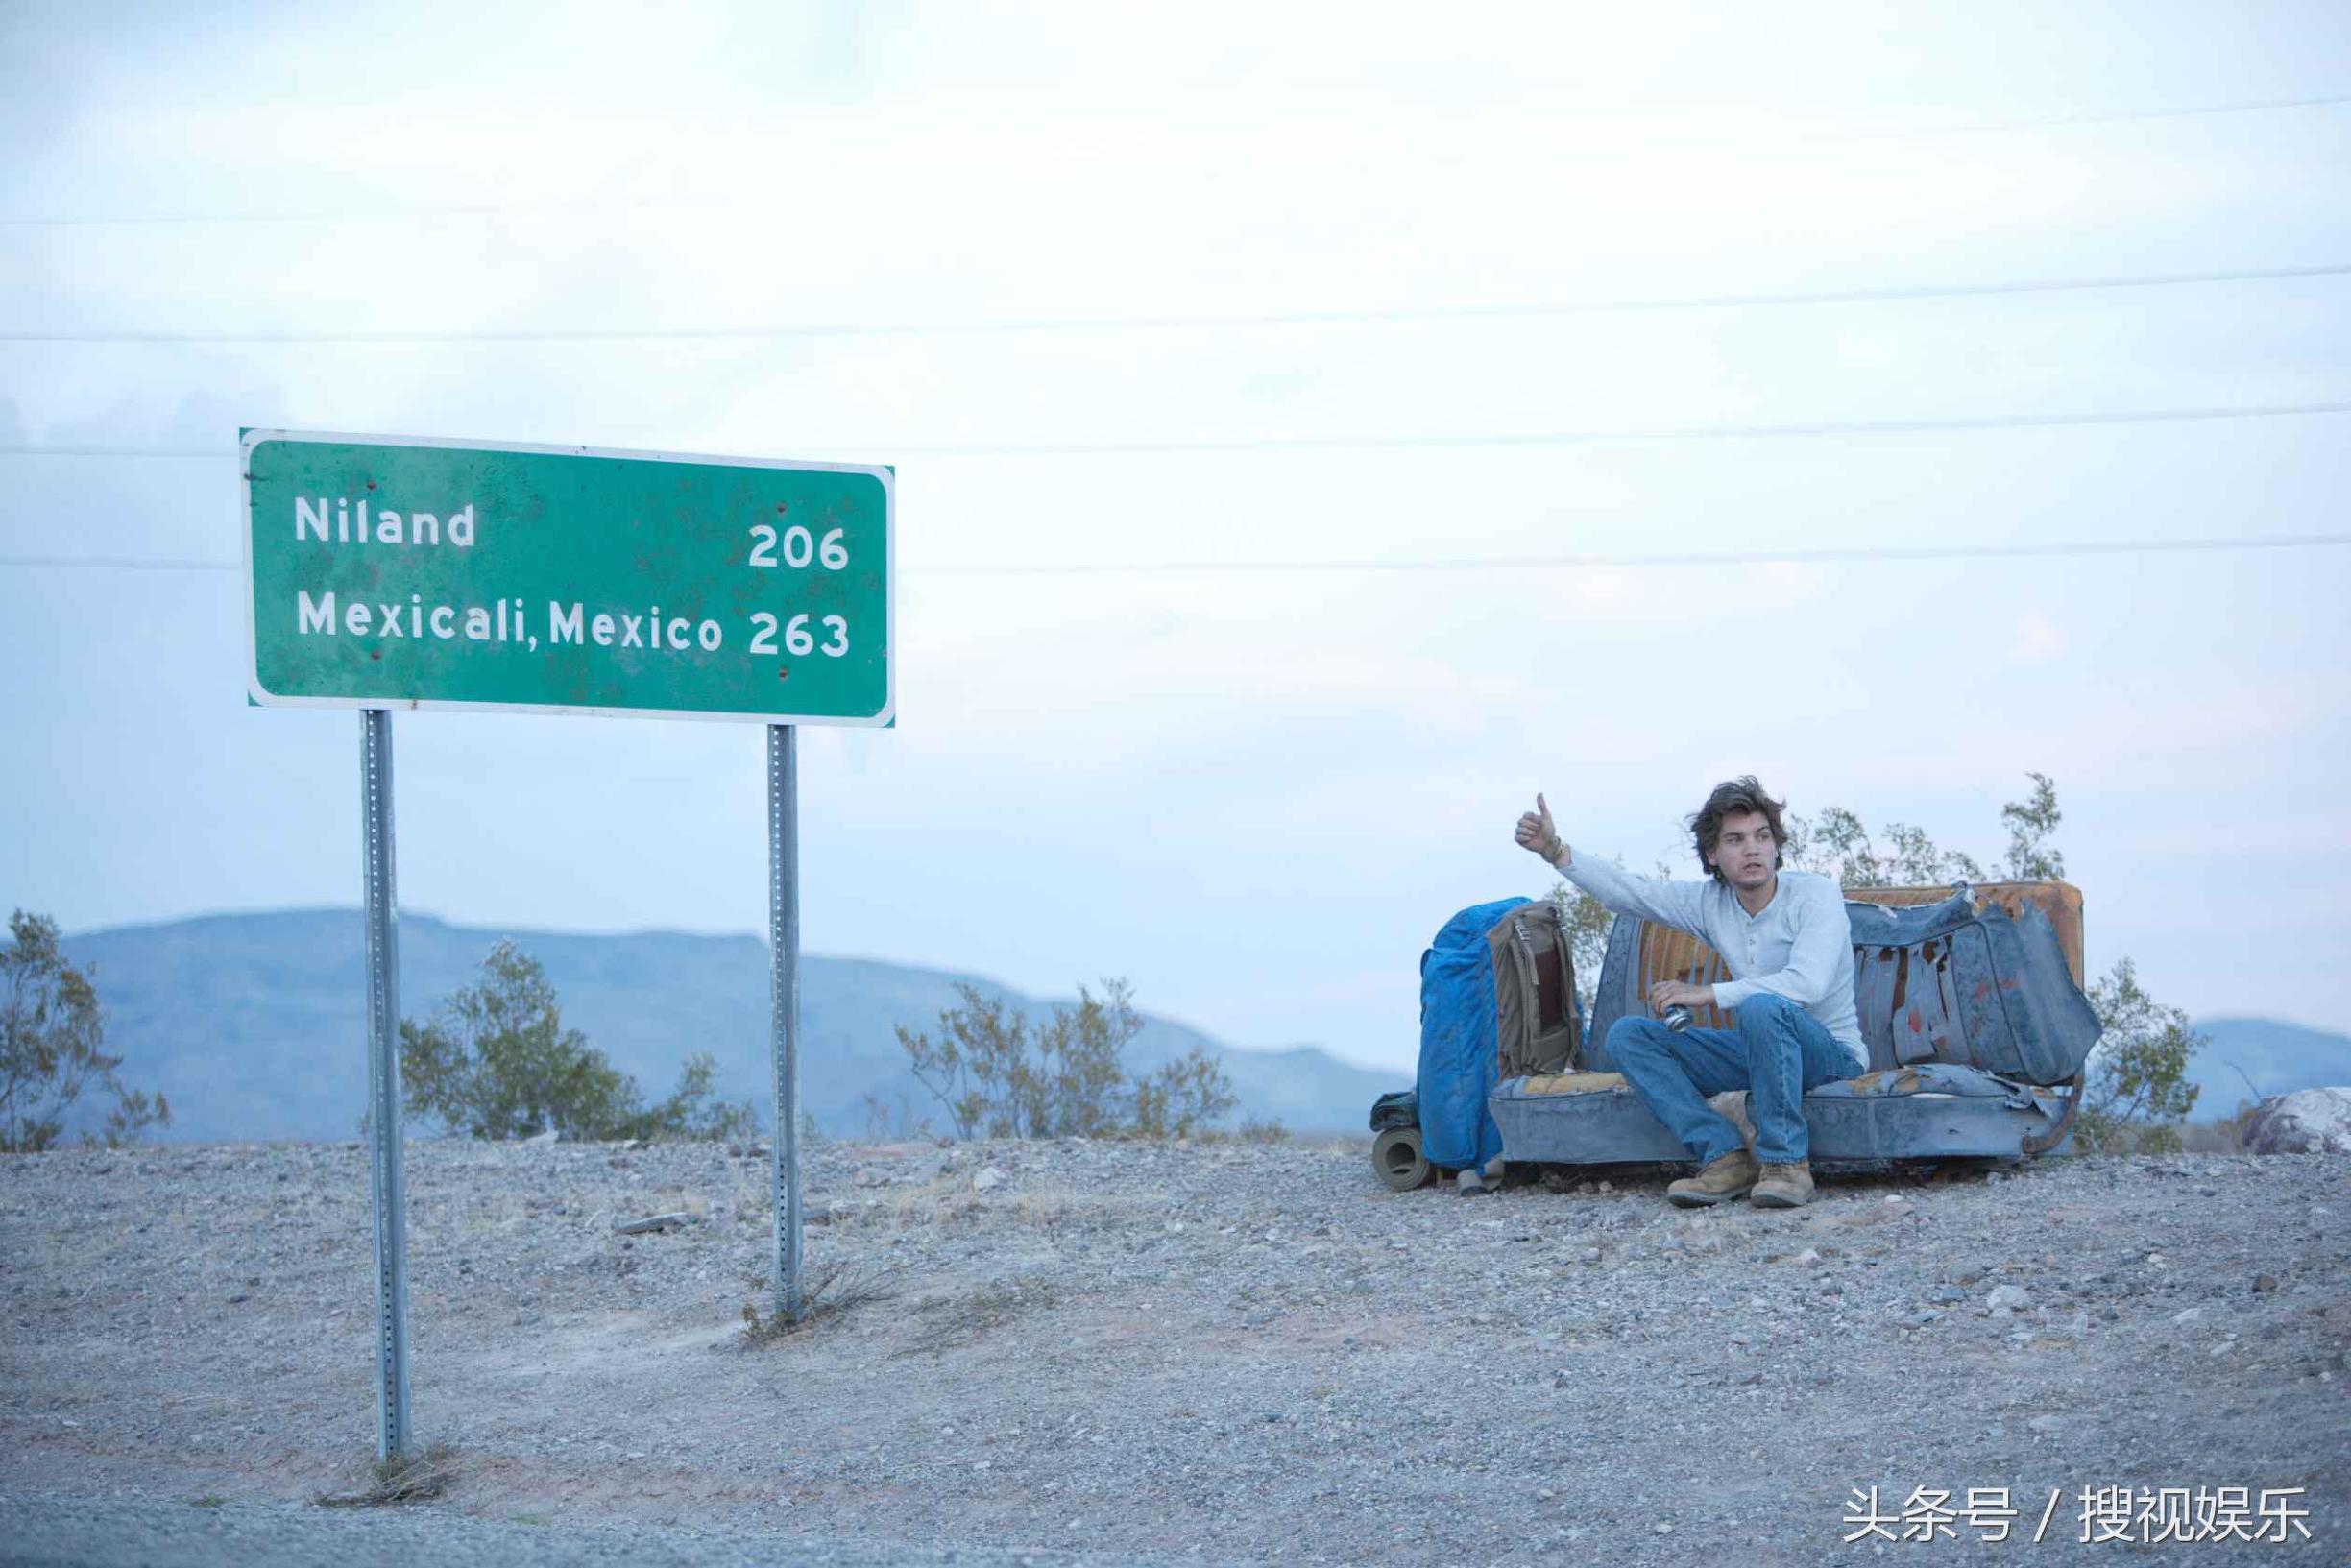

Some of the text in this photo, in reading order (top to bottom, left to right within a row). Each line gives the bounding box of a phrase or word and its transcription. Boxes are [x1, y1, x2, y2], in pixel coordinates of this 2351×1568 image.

[295, 496, 848, 570] Niland 206
[298, 591, 849, 657] Mexicali, Mexico 263
